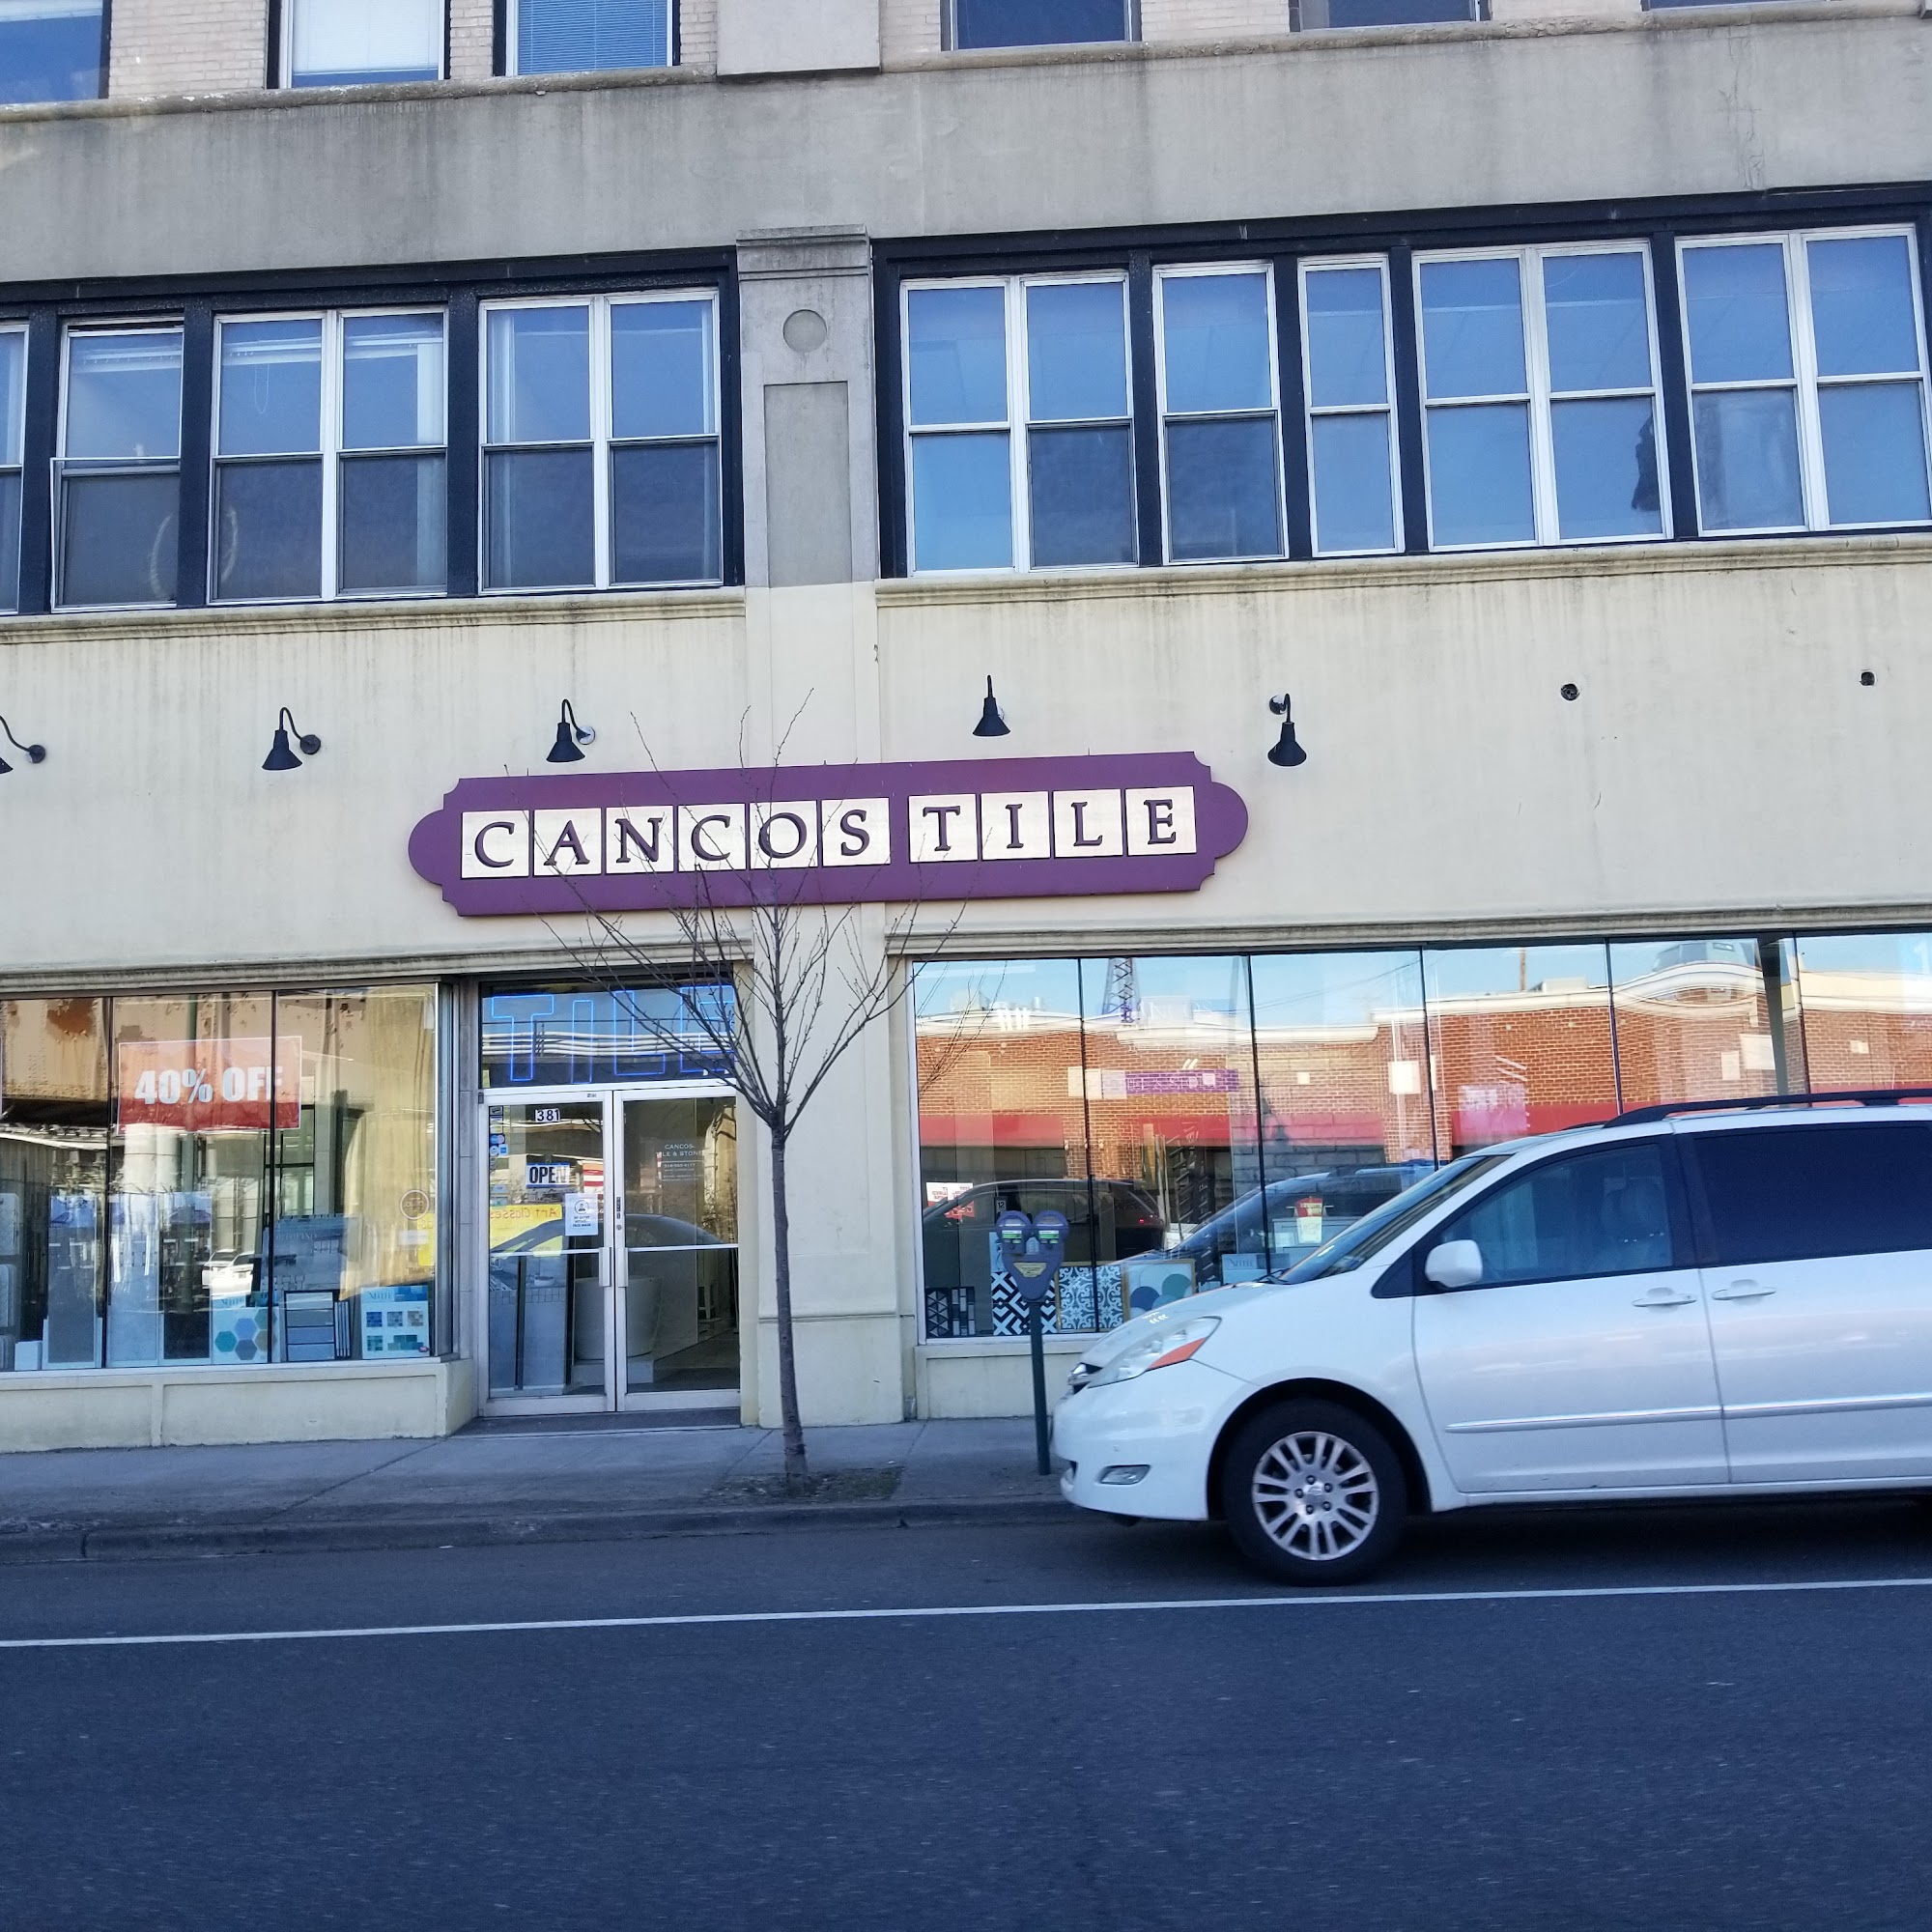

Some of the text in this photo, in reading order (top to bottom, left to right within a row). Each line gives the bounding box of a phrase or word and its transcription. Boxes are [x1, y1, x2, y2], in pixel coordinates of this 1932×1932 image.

[474, 798, 1178, 867] CANCOS TILE
[492, 985, 734, 1084] TILE
[134, 1065, 284, 1105] 40% OFF
[536, 1109, 560, 1122] 381
[528, 1166, 568, 1184] OPEN
